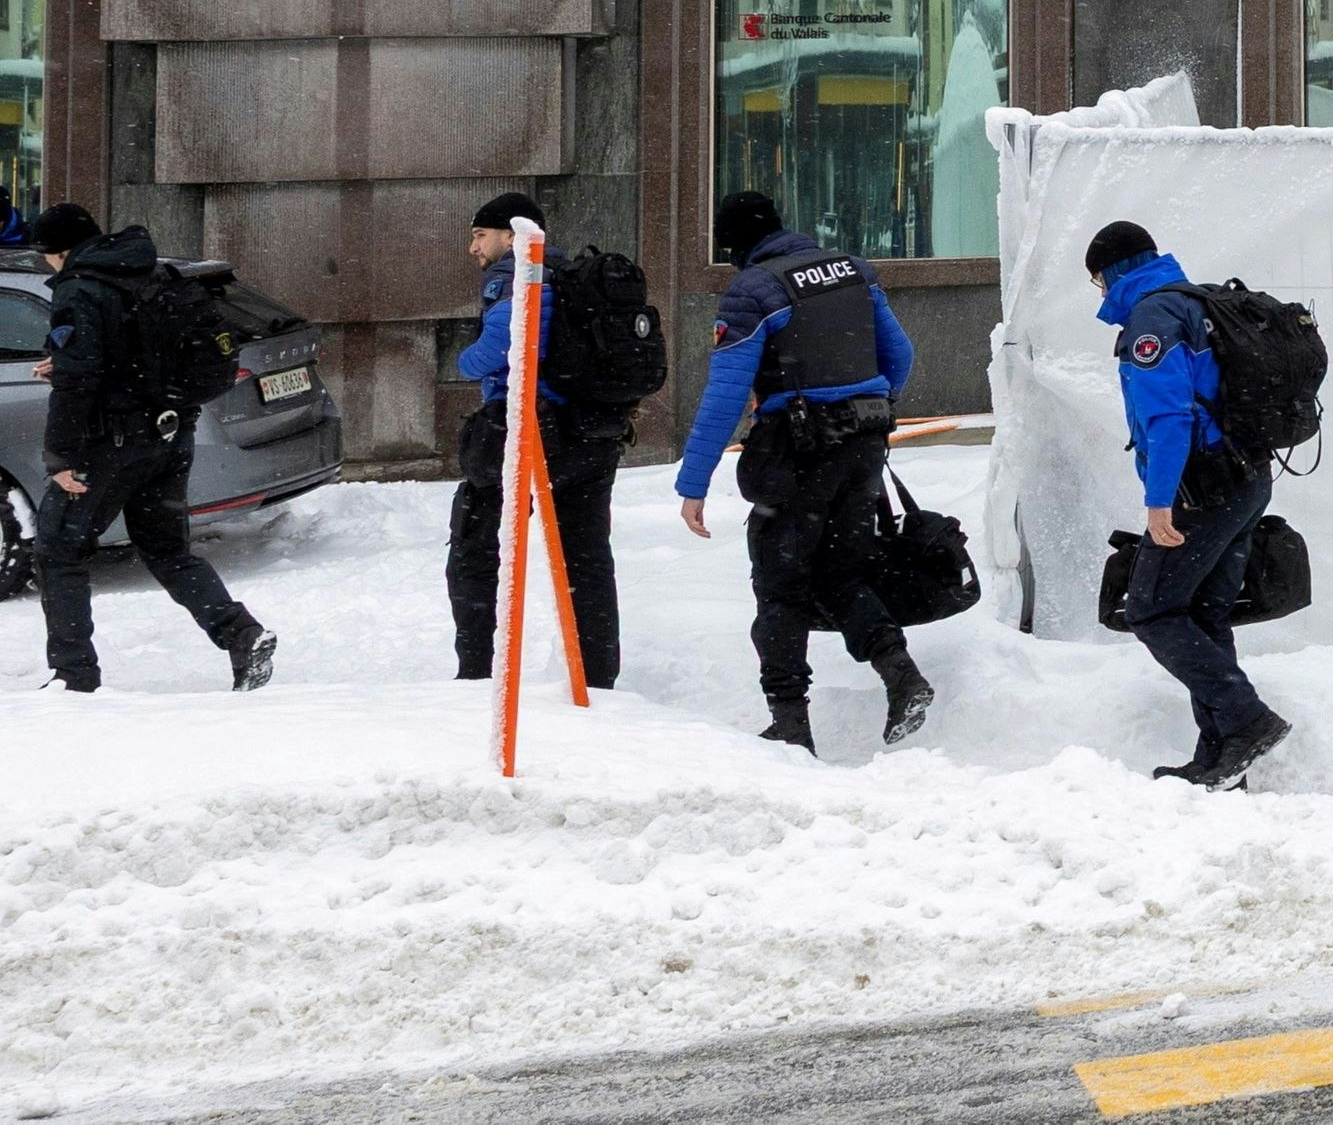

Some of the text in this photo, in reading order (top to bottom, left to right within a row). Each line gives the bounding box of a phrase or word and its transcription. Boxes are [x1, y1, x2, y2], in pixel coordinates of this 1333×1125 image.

[770, 11, 892, 26] Banque Cantonale
[770, 28, 830, 40] du Valais
[793, 260, 857, 288] POLICE
